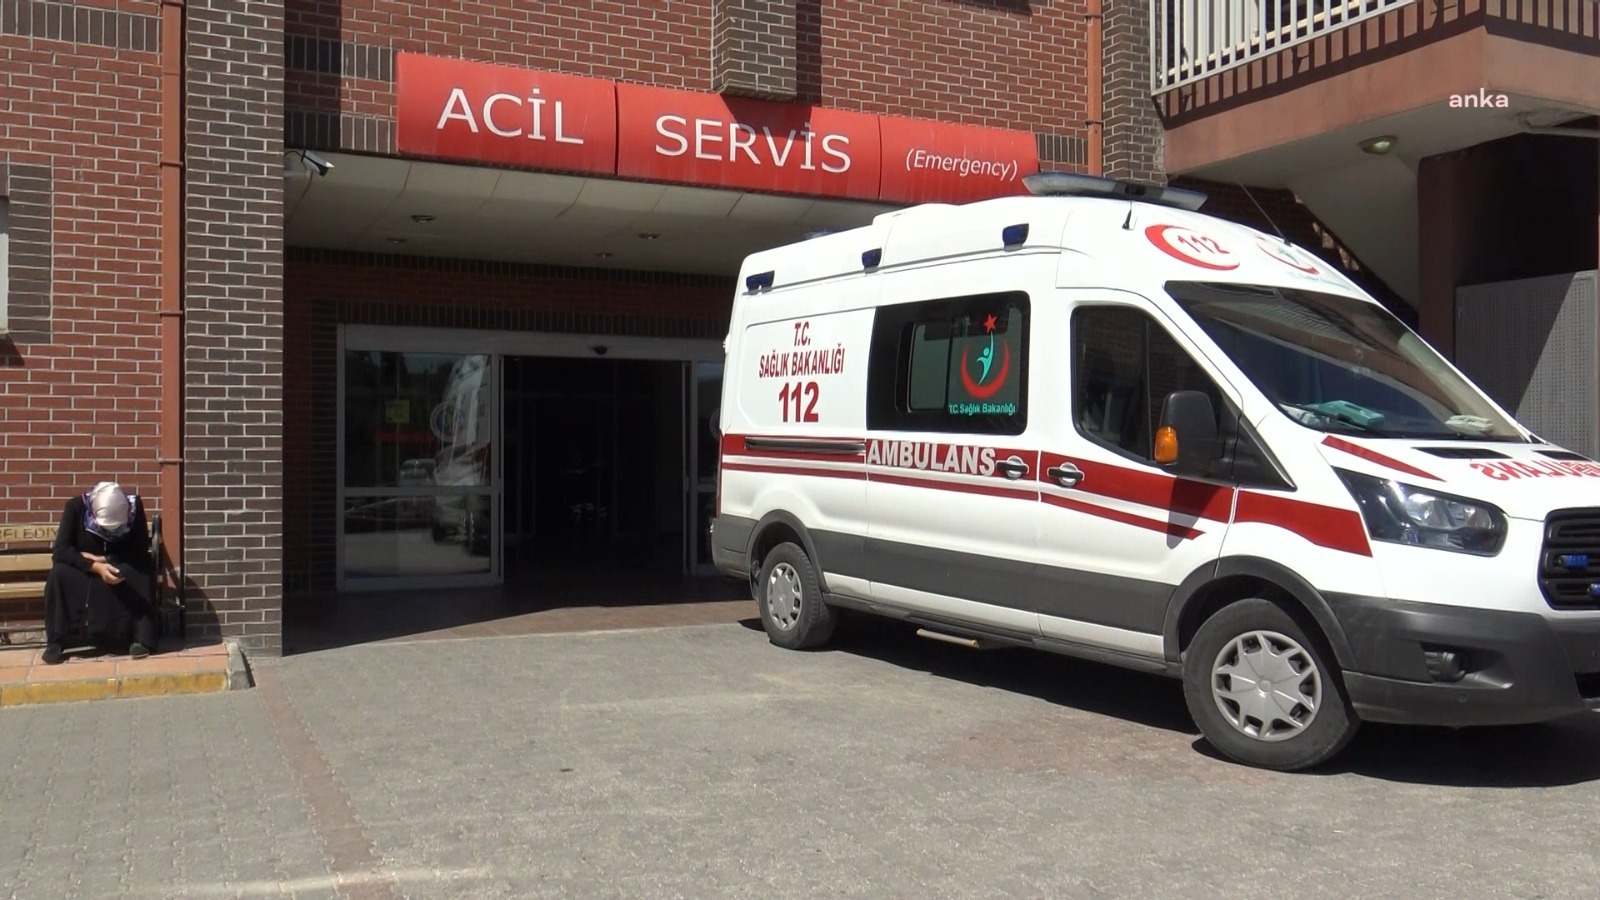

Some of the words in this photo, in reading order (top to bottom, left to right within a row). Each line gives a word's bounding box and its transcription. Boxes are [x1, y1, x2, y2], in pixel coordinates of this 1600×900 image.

[436, 87, 584, 146] ACİL
[654, 114, 852, 174] SERVİS
[905, 148, 1019, 182] (Emergency)
[1177, 234, 1230, 254] 112
[794, 321, 811, 347] T.C.
[759, 348, 790, 378] SAĞLIK
[791, 342, 845, 376] BAKANLIĞI
[778, 381, 820, 423] 112
[960, 403, 980, 416] Sağlık
[867, 439, 996, 476] AMBULANS
